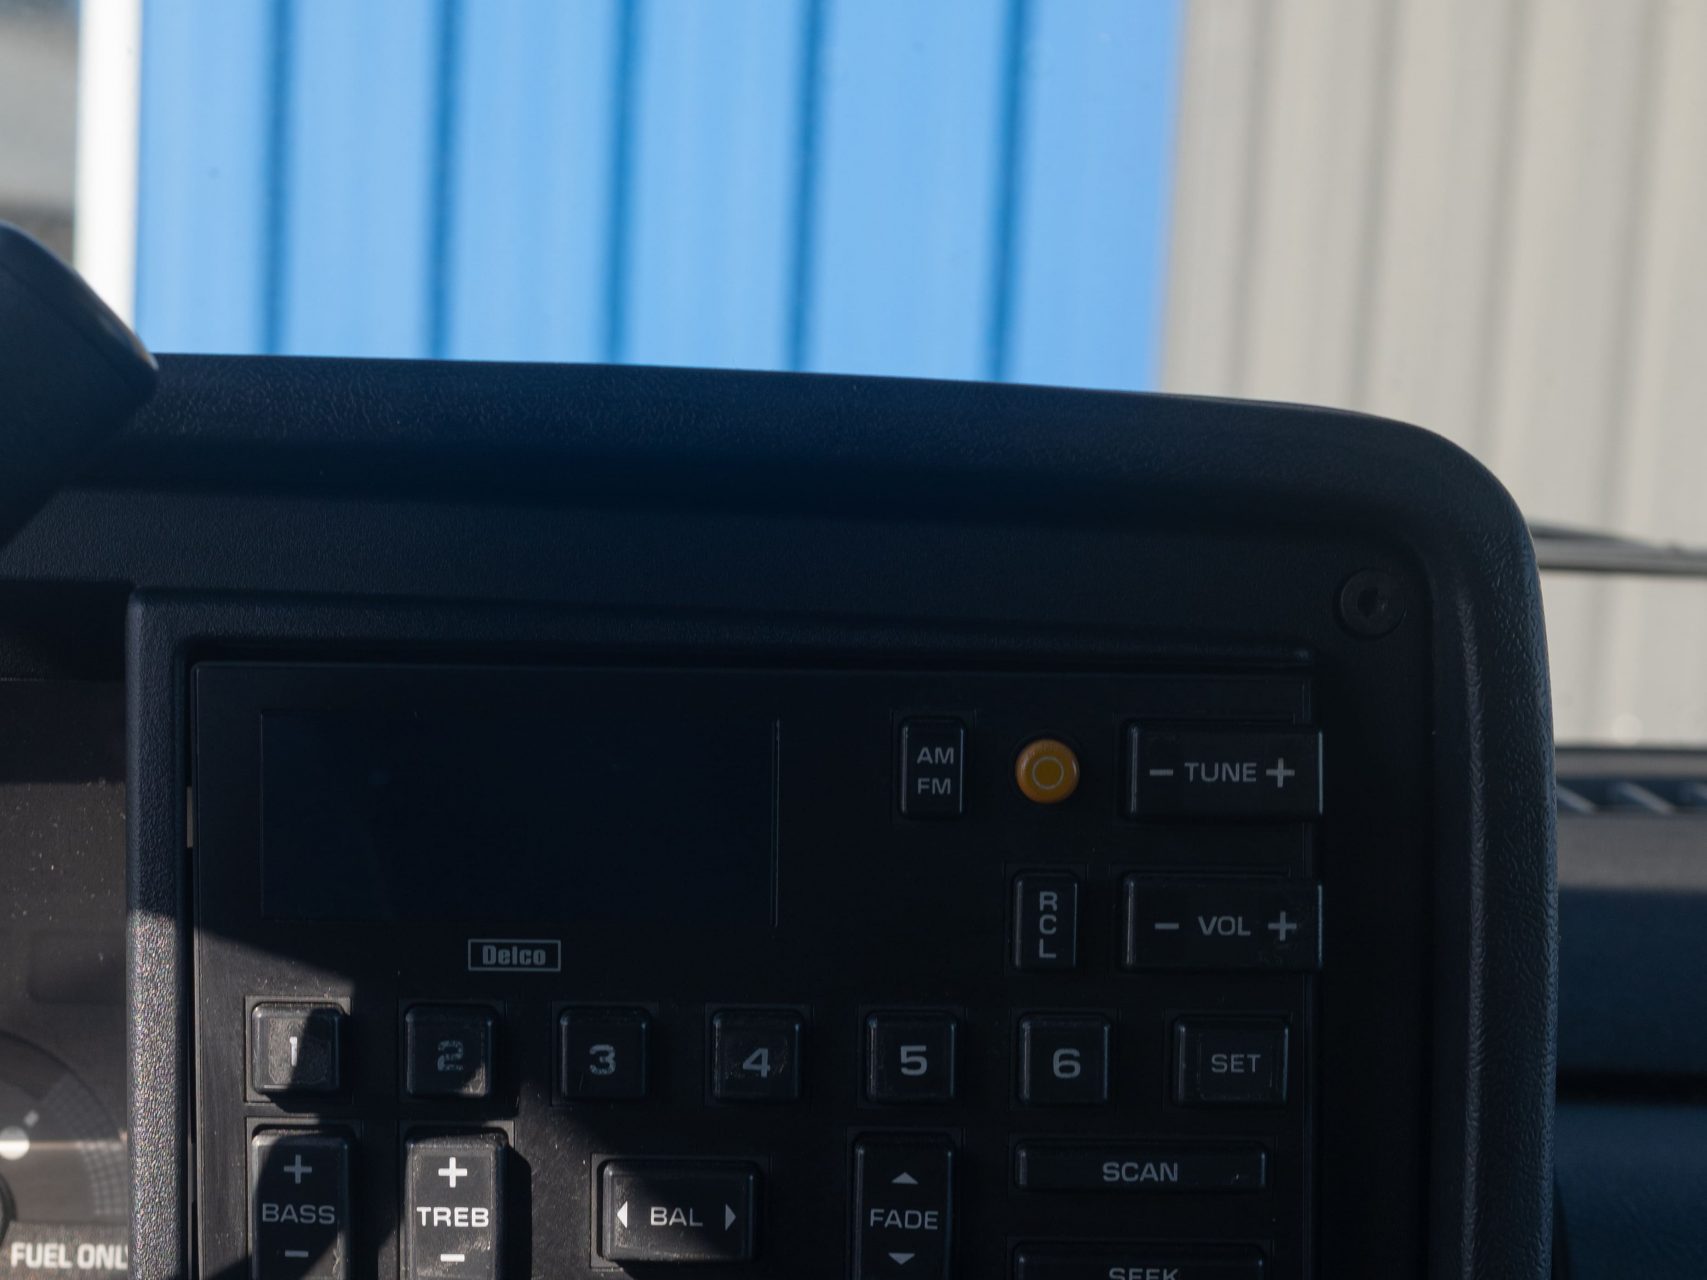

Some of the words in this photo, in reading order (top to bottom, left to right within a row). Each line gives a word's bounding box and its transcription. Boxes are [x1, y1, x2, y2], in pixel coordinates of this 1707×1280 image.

[916, 747, 955, 765] AM
[1185, 762, 1257, 783] TUNE
[917, 778, 951, 795] FM
[1198, 916, 1251, 937] VOL
[481, 945, 547, 967] Delco
[289, 1036, 299, 1066] 1
[437, 1041, 464, 1073] 2
[589, 1044, 616, 1074] 3
[742, 1047, 770, 1077] 4
[900, 1045, 927, 1076] 5
[1052, 1047, 1080, 1079] 6
[1211, 1054, 1260, 1074] SET
[1102, 1161, 1178, 1183] SCAN
[262, 1203, 335, 1225] BASS
[417, 1206, 489, 1227] TREB
[650, 1206, 704, 1228] BAL
[870, 1209, 938, 1230] FADE
[11, 1242, 71, 1268] FUEL
[77, 1243, 128, 1269] ONL
